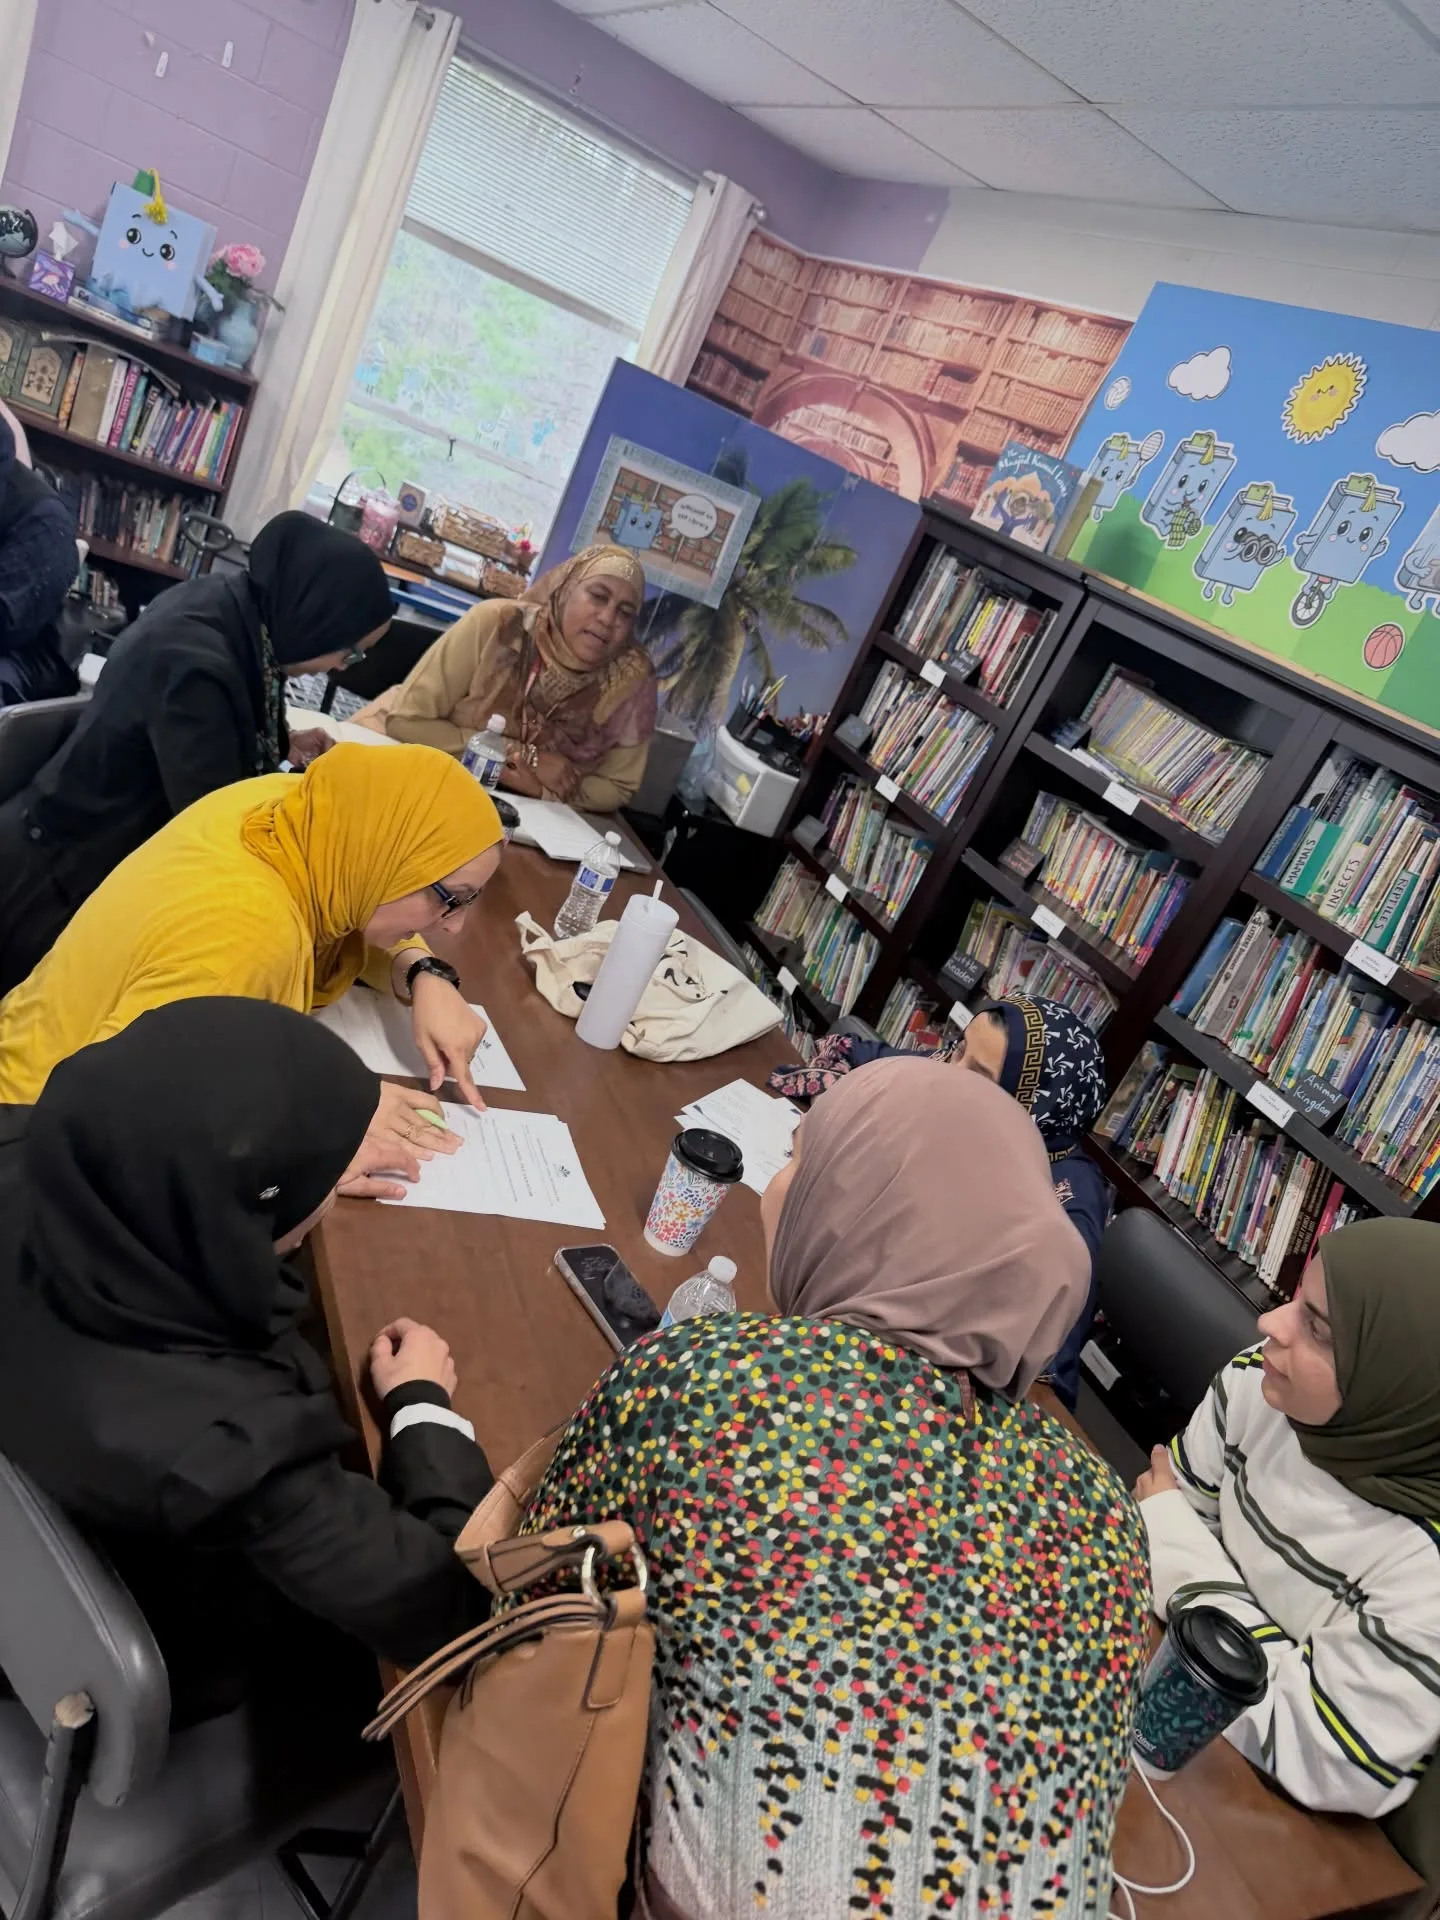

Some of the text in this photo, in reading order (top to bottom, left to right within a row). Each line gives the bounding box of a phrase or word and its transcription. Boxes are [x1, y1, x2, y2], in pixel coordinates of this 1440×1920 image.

[1286, 838, 1316, 884] MAMMALS
[1326, 859, 1360, 909] INSECTS
[1374, 878, 1408, 930] REPTILES
[944, 959, 975, 983] Reader
[953, 951, 978, 973] Little
[1295, 1084, 1331, 1118] Kingdom
[1303, 1074, 1342, 1104] Animal
